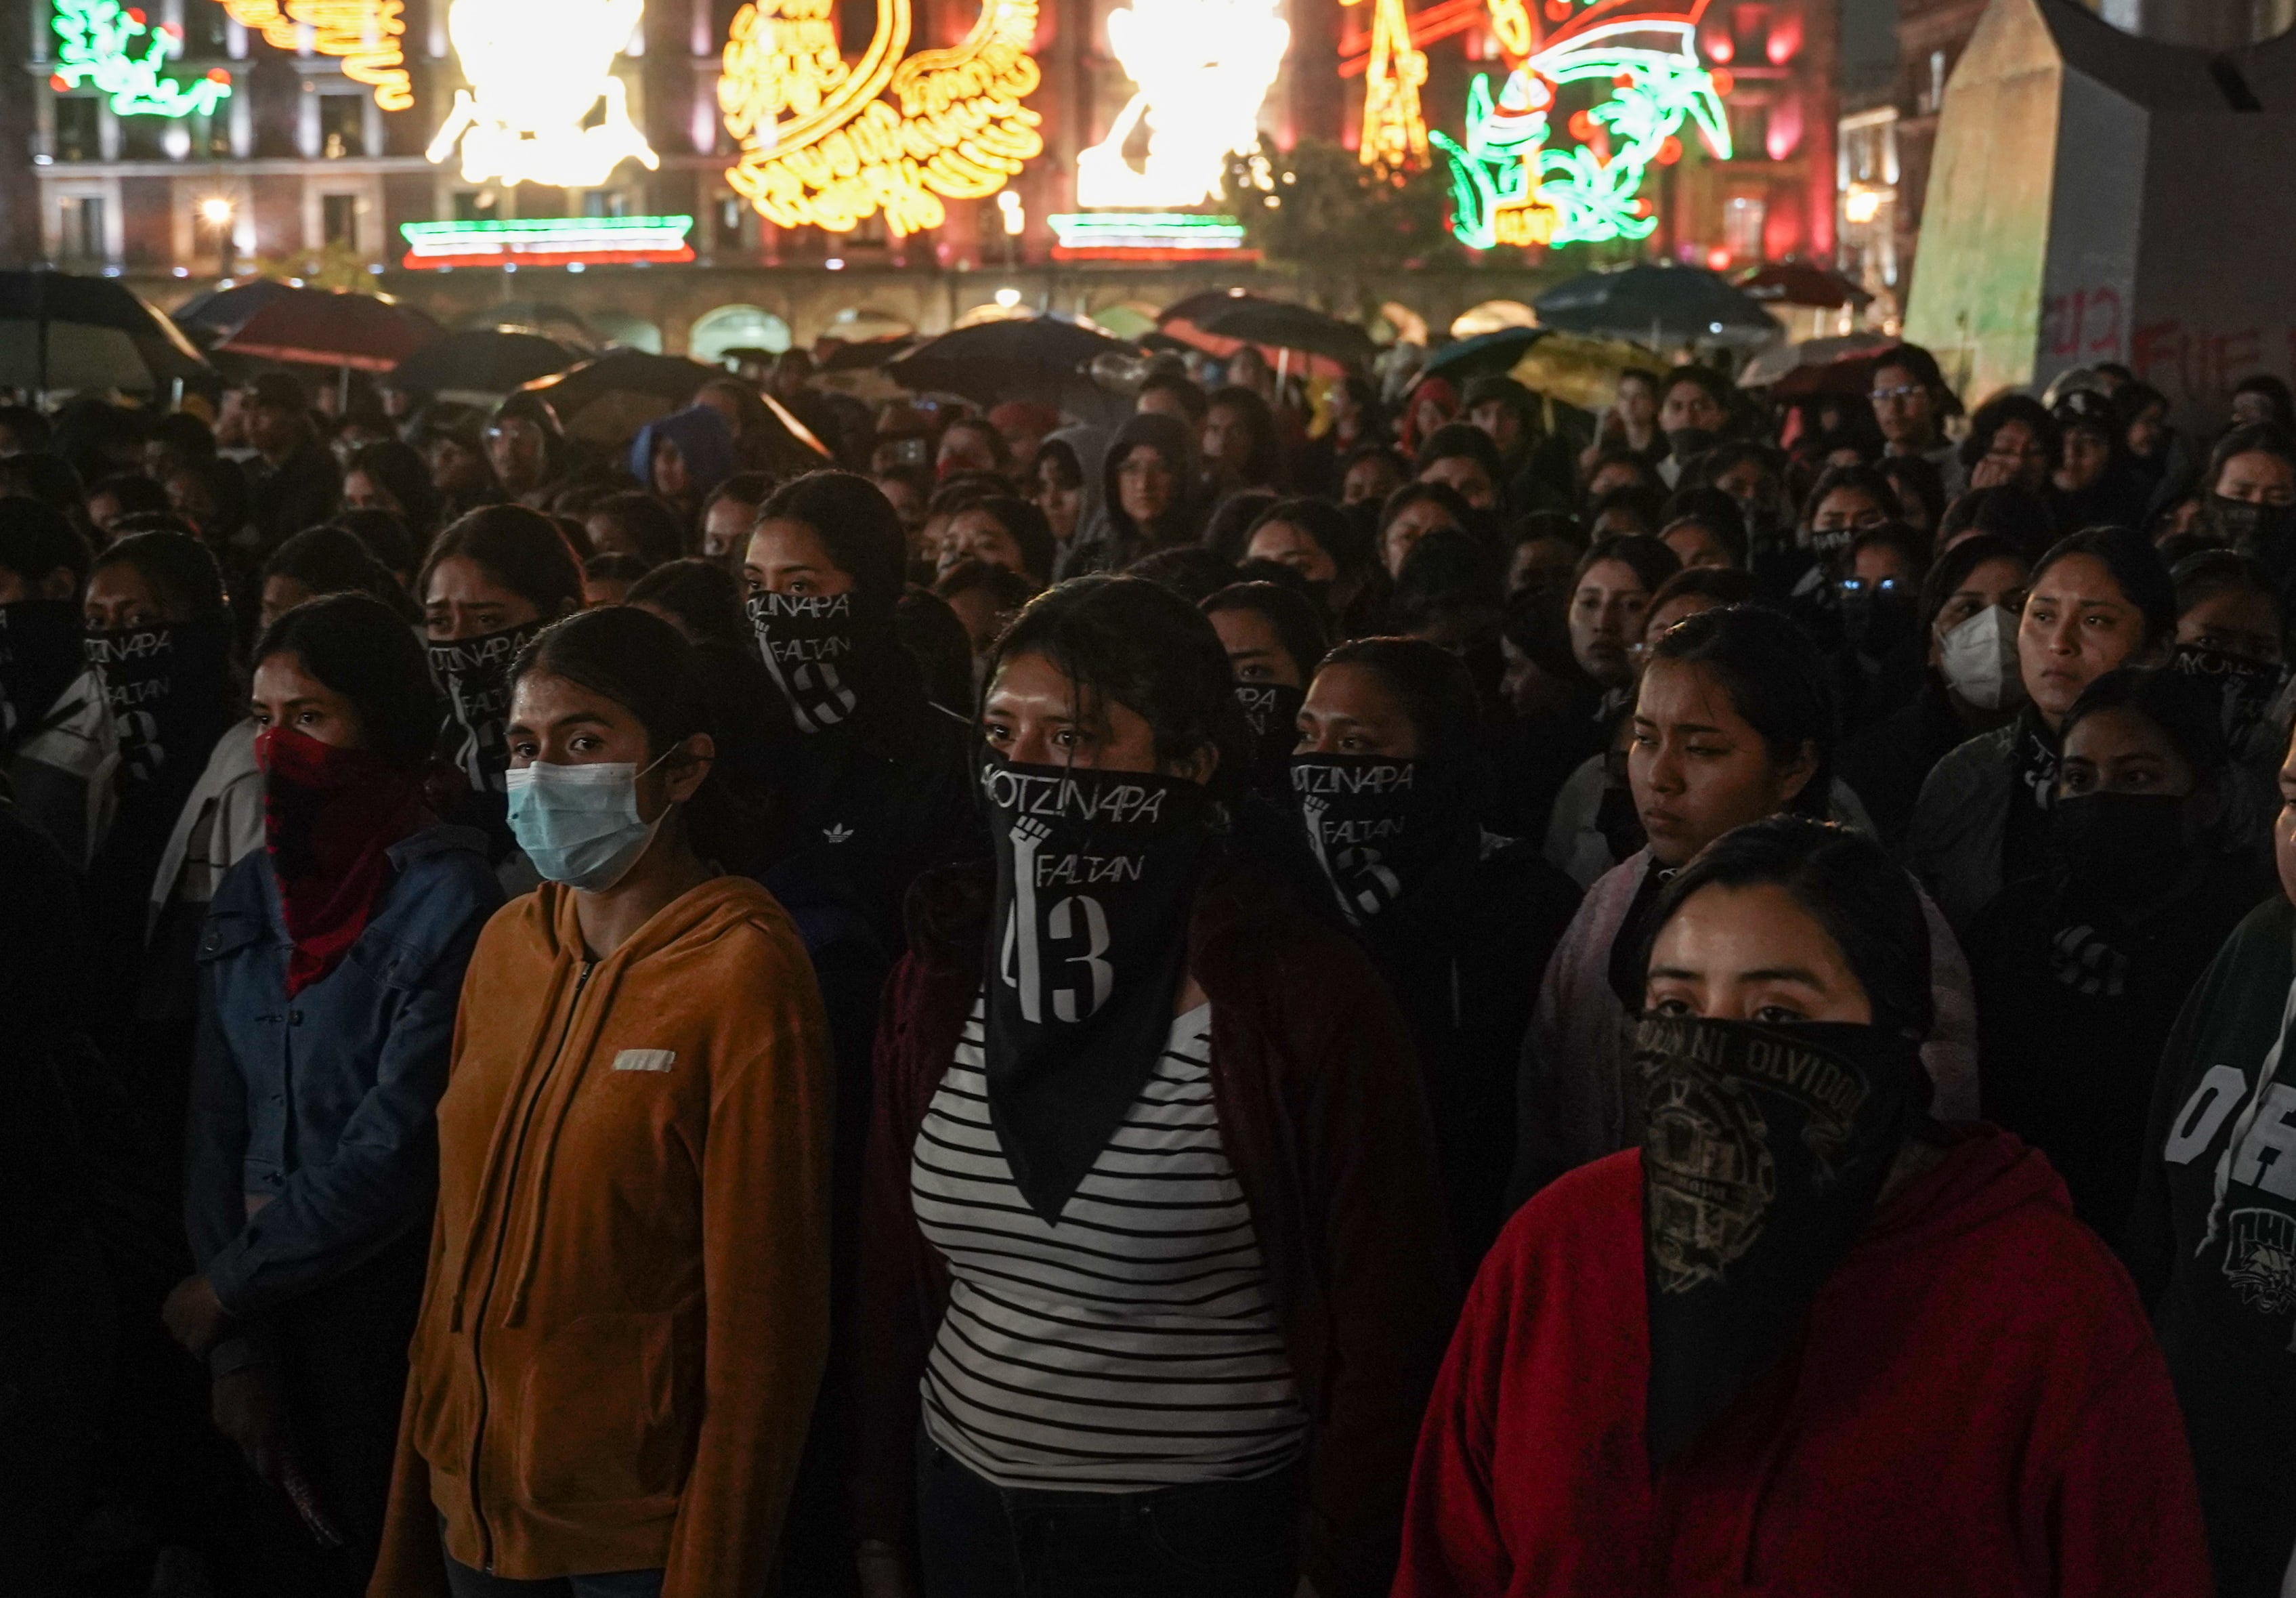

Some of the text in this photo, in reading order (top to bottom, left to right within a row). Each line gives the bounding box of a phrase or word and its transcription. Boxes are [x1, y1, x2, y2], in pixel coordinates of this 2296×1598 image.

[769, 635, 851, 663] FALTAN
[1321, 816, 1405, 845] FALTAN
[1036, 854, 1146, 888] FALTAN
[1000, 893, 1115, 1024] 43
